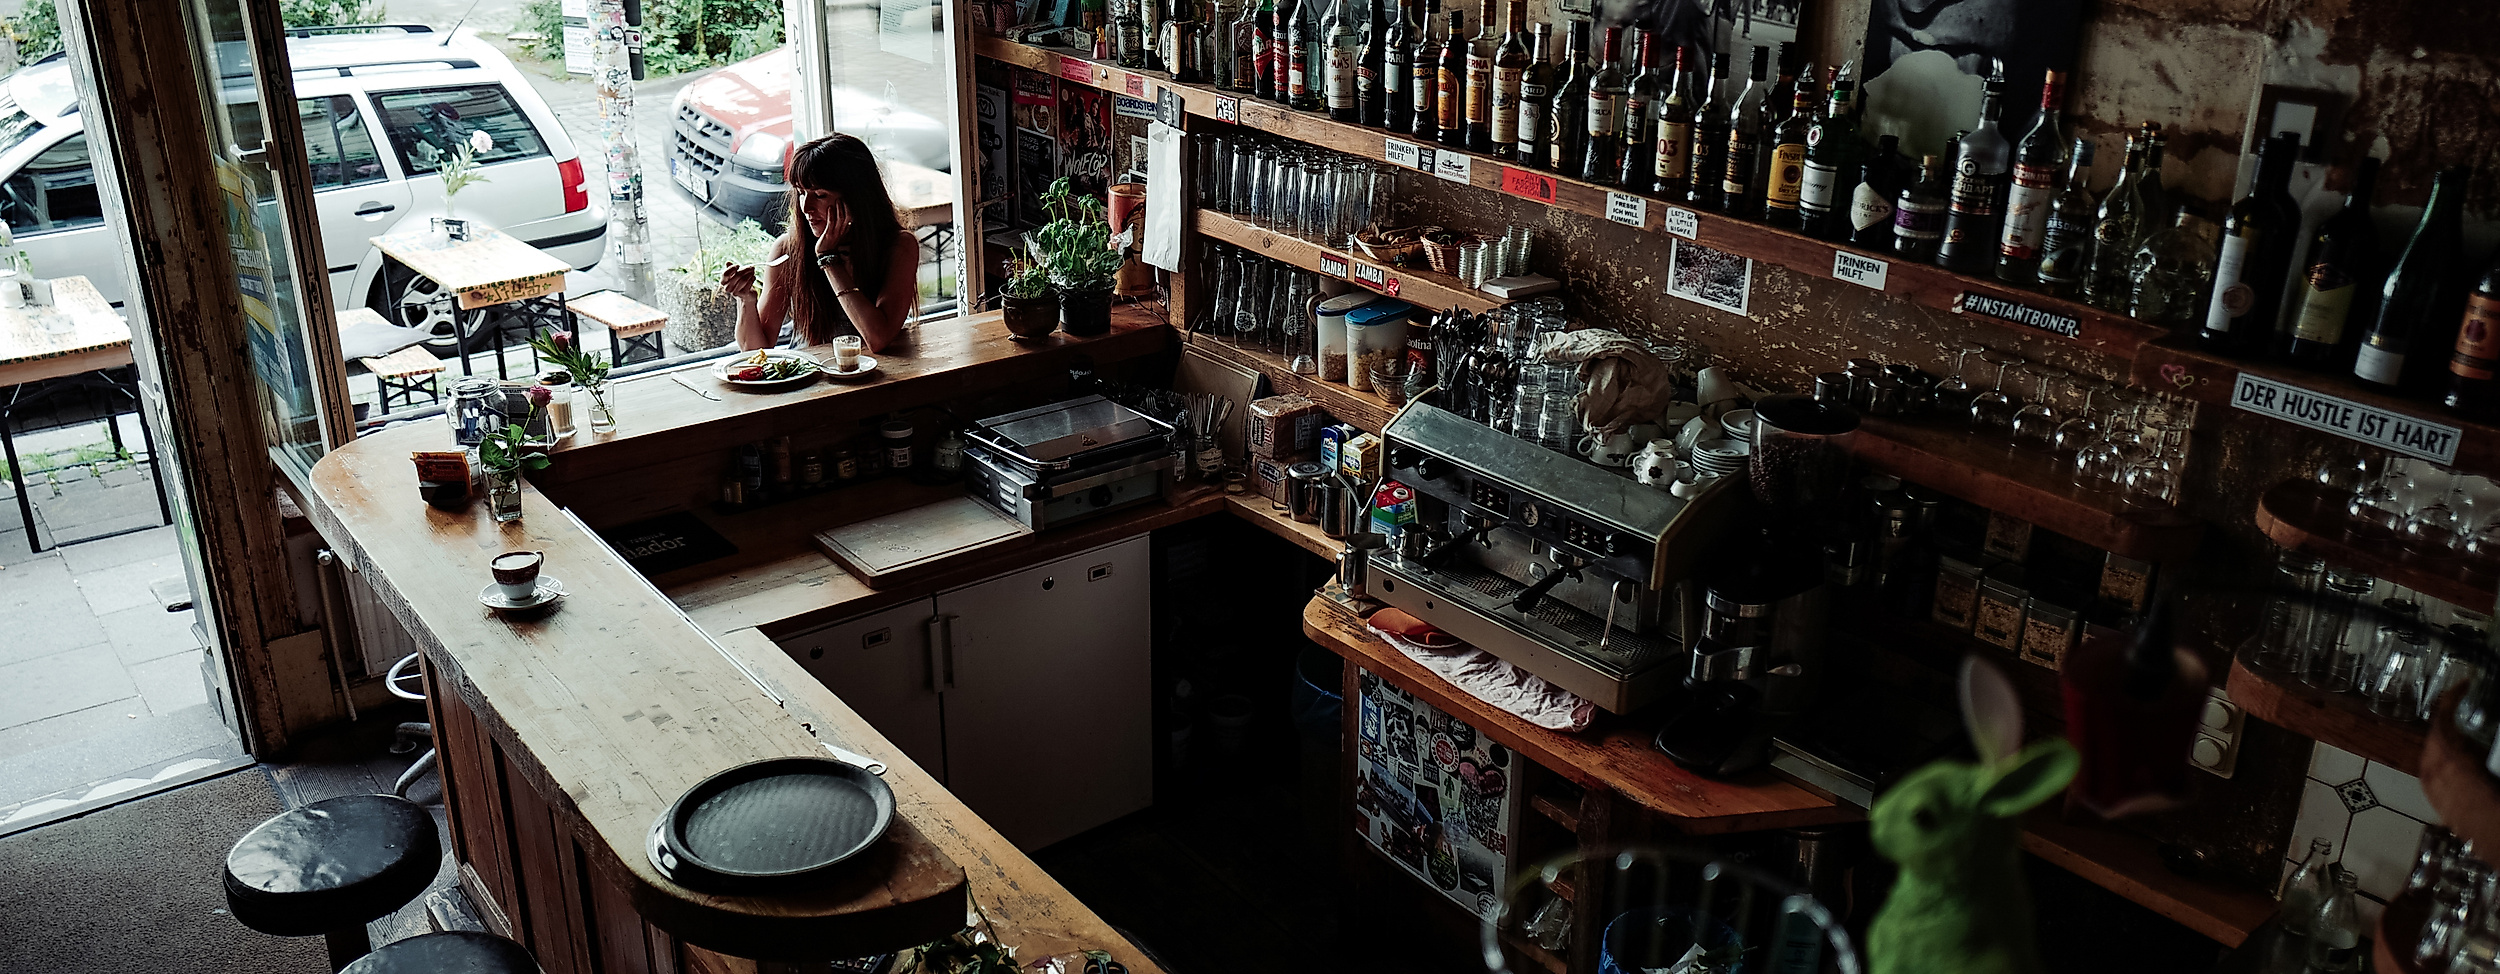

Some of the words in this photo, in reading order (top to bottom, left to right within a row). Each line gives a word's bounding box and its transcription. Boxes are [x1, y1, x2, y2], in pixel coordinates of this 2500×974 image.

[1217, 98, 1235, 111] FCK
[1217, 108, 1235, 121] AFD
[1387, 142, 1415, 155] TRINKEN
[1387, 151, 1406, 162] HILFT.
[1613, 192, 1629, 200] HALT
[1616, 201, 1638, 210] FRESSE
[1611, 215, 1640, 226] FUMMELN
[1624, 210, 1639, 219] WILL
[1838, 254, 1881, 274] TRINKEN
[1321, 257, 1348, 279] RAMBA
[1356, 262, 1383, 285] ZAMBA
[1837, 265, 1864, 281] HILFT.
[2240, 381, 2277, 410] DER
[2282, 392, 2353, 430] HUSTLE
[2357, 412, 2389, 439] IST
[2392, 421, 2452, 455] HART
